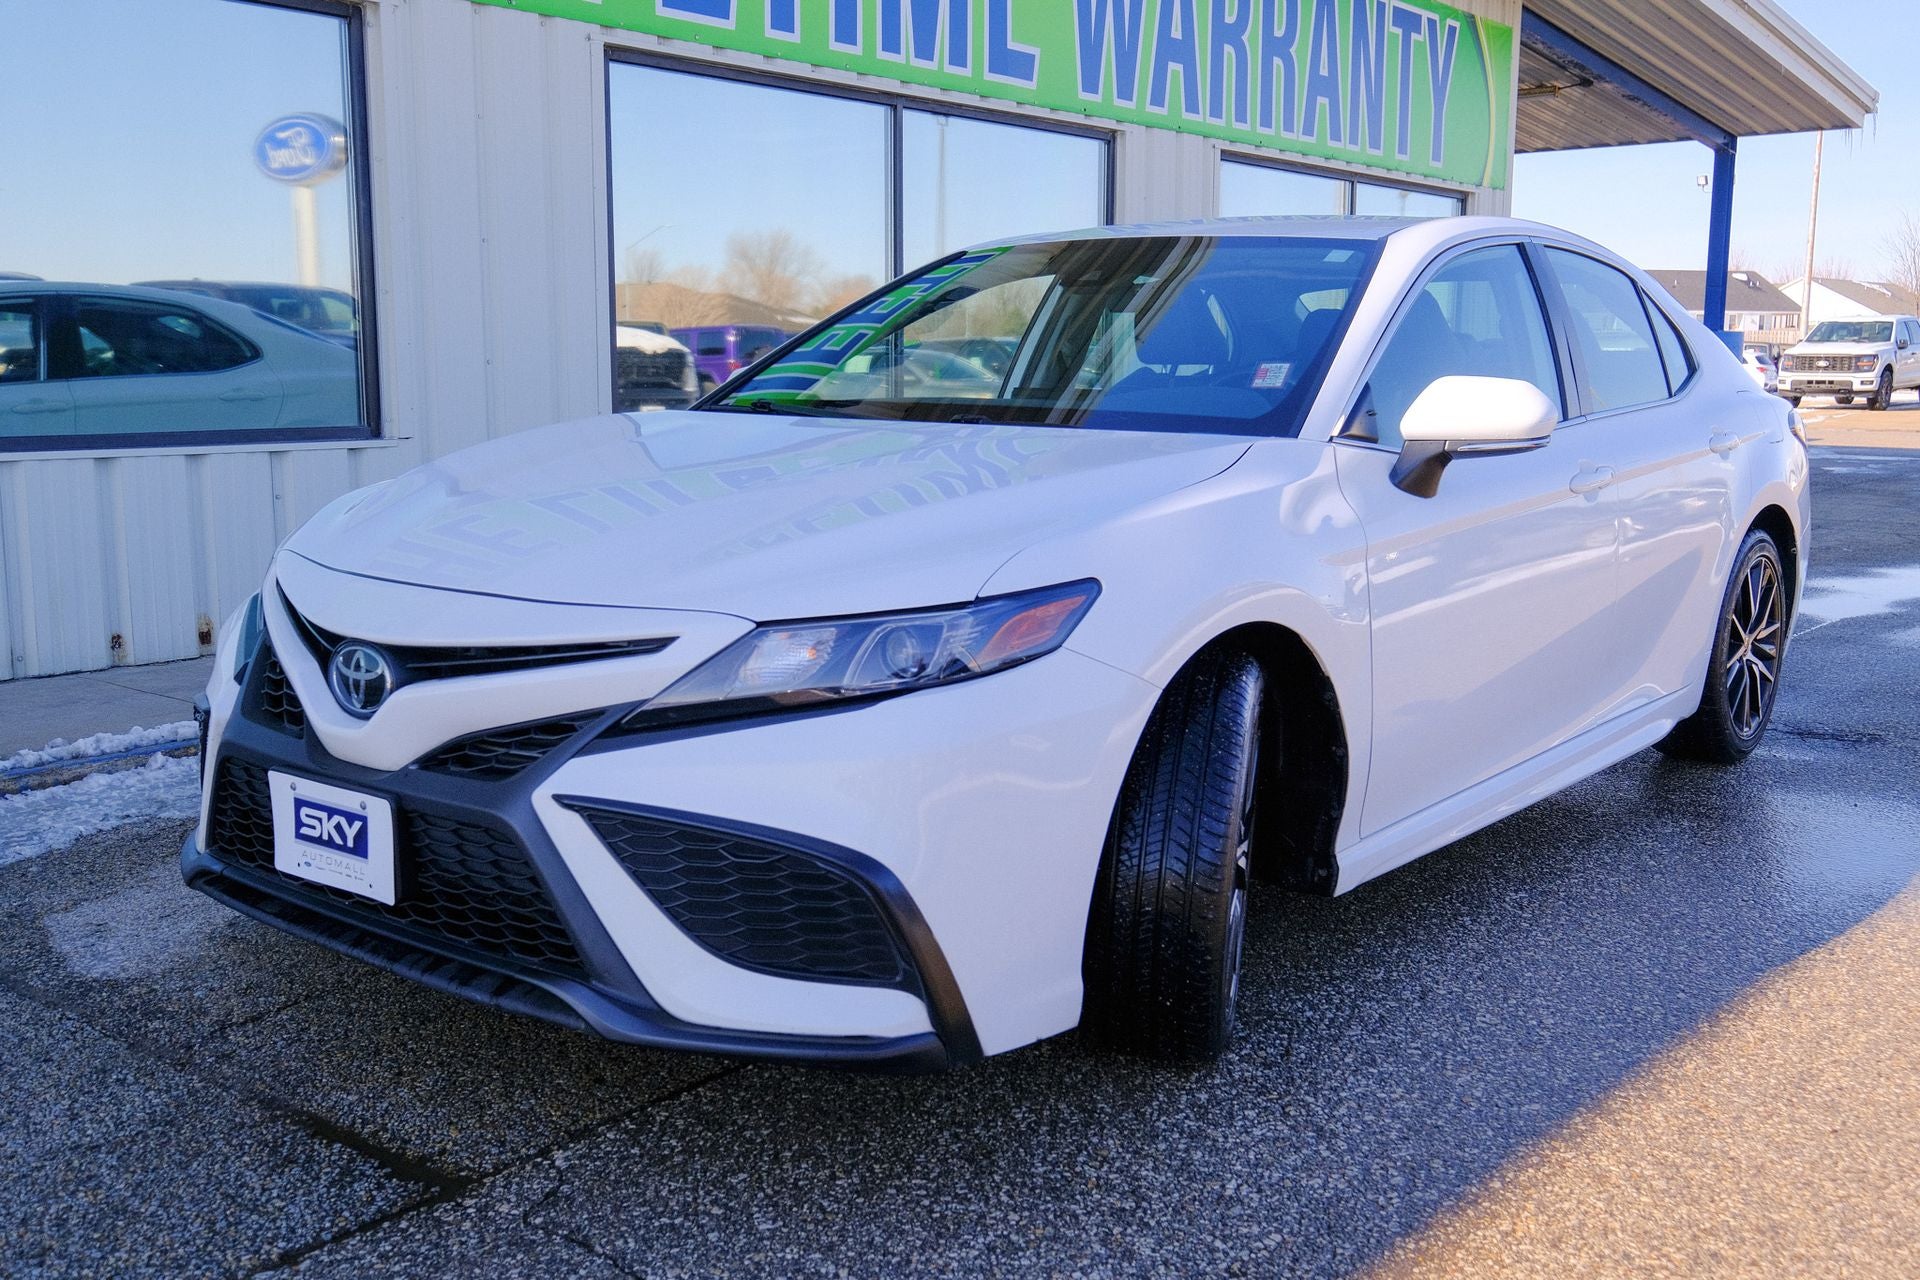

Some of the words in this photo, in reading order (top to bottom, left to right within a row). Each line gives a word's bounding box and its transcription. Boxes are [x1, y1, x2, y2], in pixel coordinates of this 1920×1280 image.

[1074, 0, 1461, 168] WARRANTY
[300, 806, 363, 848] SKY
[301, 850, 366, 876] AUTOMALL
